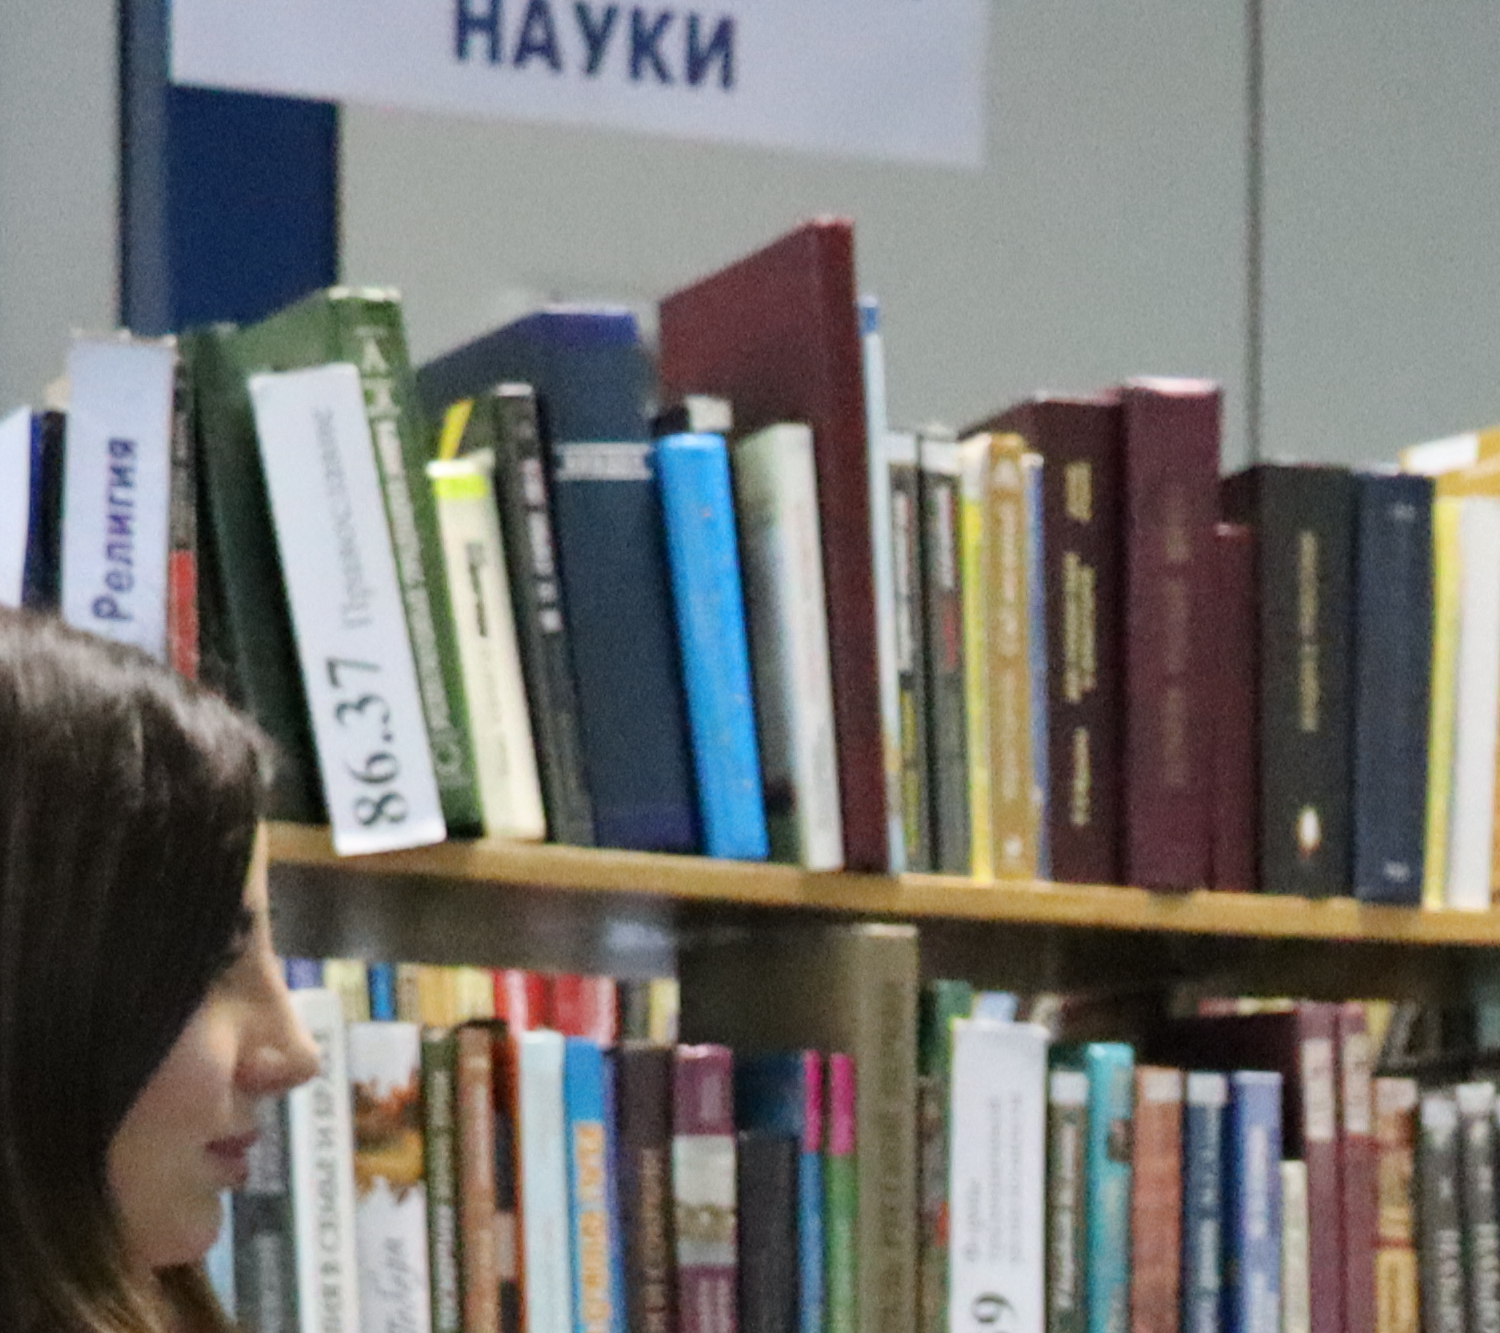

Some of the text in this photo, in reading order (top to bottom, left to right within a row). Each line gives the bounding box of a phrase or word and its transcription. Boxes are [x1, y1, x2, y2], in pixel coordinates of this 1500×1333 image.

[453, 0, 736, 91] НАУКИ
[92, 436, 137, 621] Религия
[325, 655, 408, 829] 86.37
